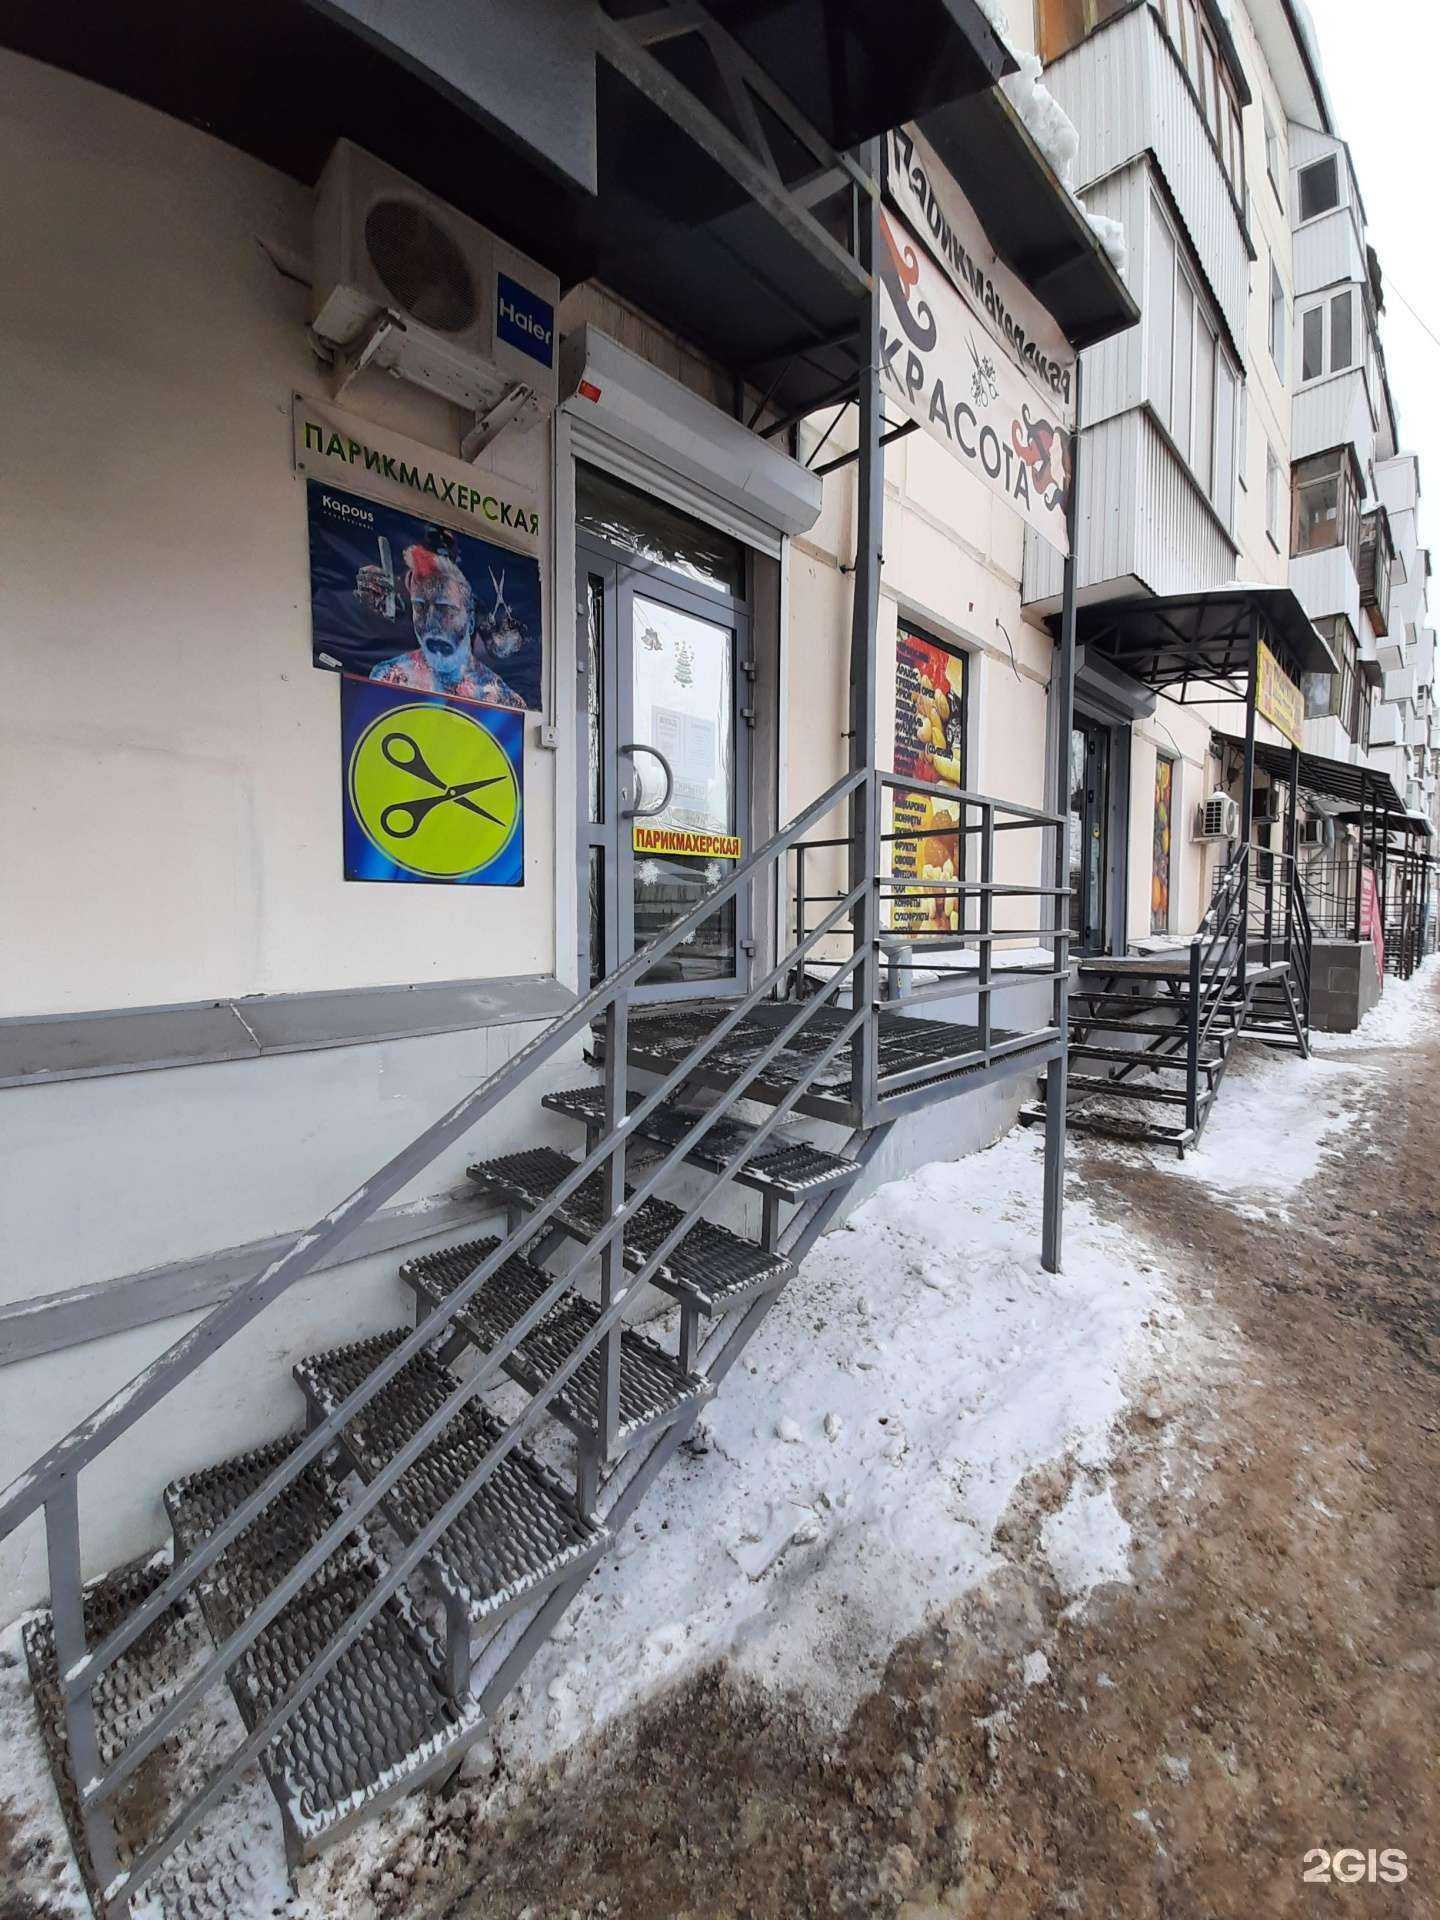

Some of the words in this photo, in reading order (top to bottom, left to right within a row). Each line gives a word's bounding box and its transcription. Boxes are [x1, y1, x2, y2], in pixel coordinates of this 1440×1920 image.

[498, 297, 552, 347] Haier
[879, 326, 1031, 512] КРАСОТА
[304, 422, 541, 537] ПАРИКМАХЕРСКАЯ
[321, 494, 375, 523] Kapous
[636, 828, 740, 857] ПАРИКМАХЕРСКАЯ
